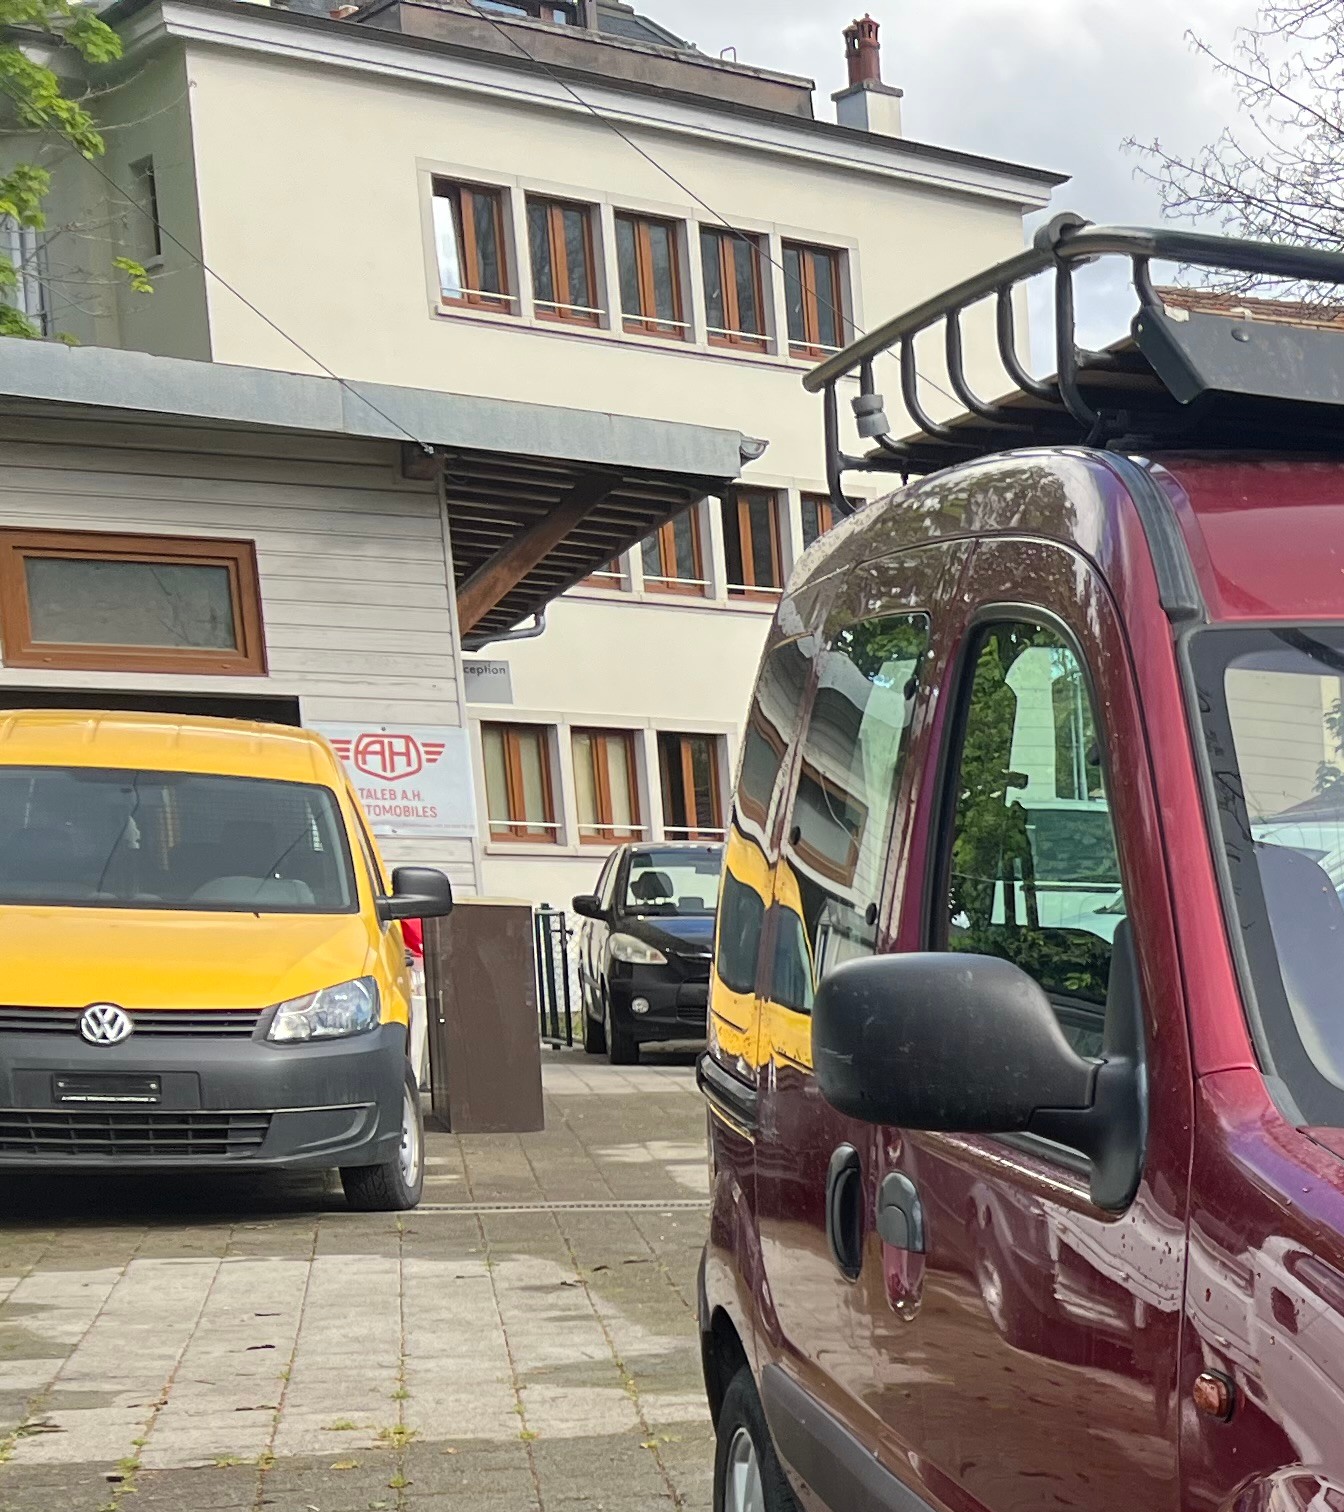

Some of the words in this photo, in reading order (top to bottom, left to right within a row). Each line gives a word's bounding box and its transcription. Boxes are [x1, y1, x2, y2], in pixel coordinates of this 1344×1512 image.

[463, 664, 506, 676] ception
[357, 738, 412, 773] AH
[358, 787, 397, 801] TALEB
[363, 804, 438, 818] TOMOBILES
